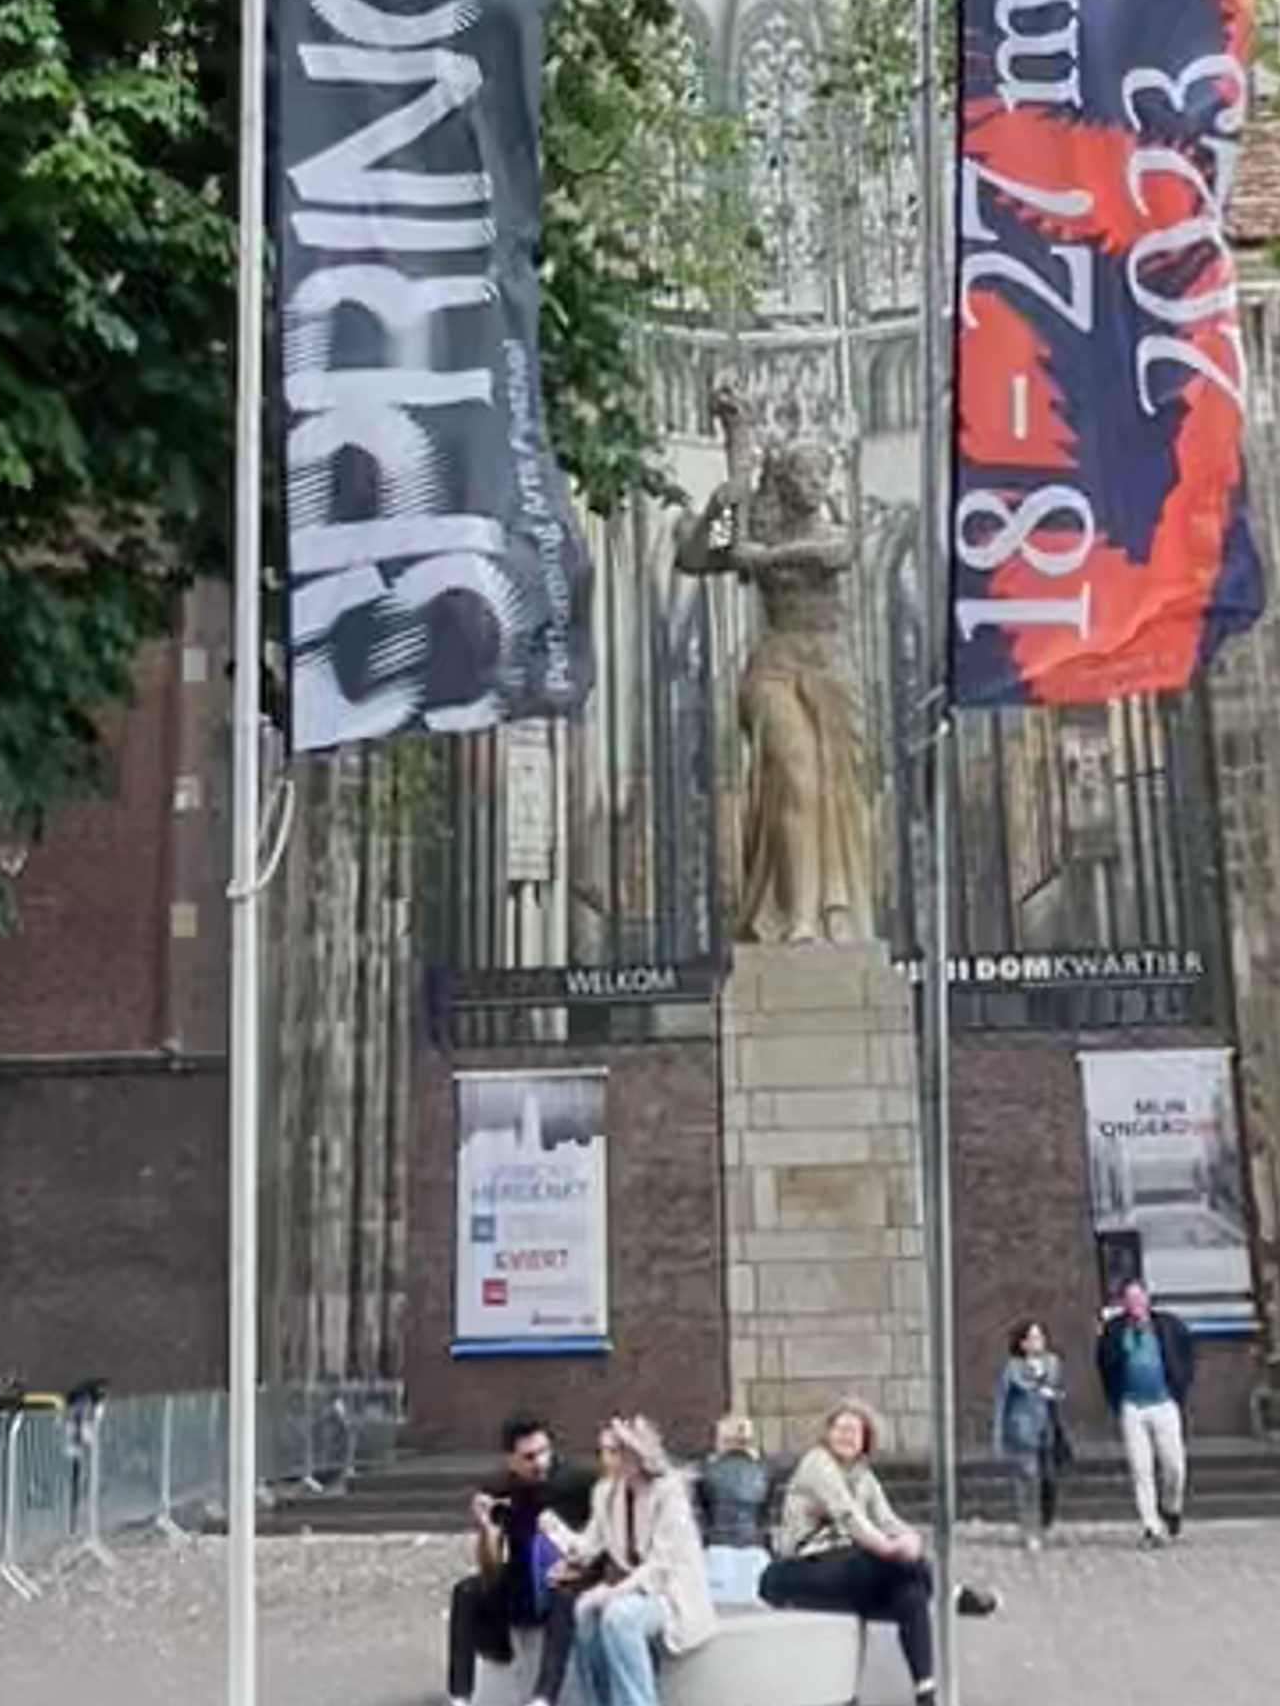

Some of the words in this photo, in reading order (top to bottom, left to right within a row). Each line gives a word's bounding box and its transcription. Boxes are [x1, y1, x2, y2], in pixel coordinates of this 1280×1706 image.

[960, 156, 1096, 329] 27
[1122, 53, 1247, 417] 2023
[956, 484, 1094, 641] 18
[567, 968, 677, 994] WELKOM
[975, 950, 1205, 982] DOMKWARTIER
